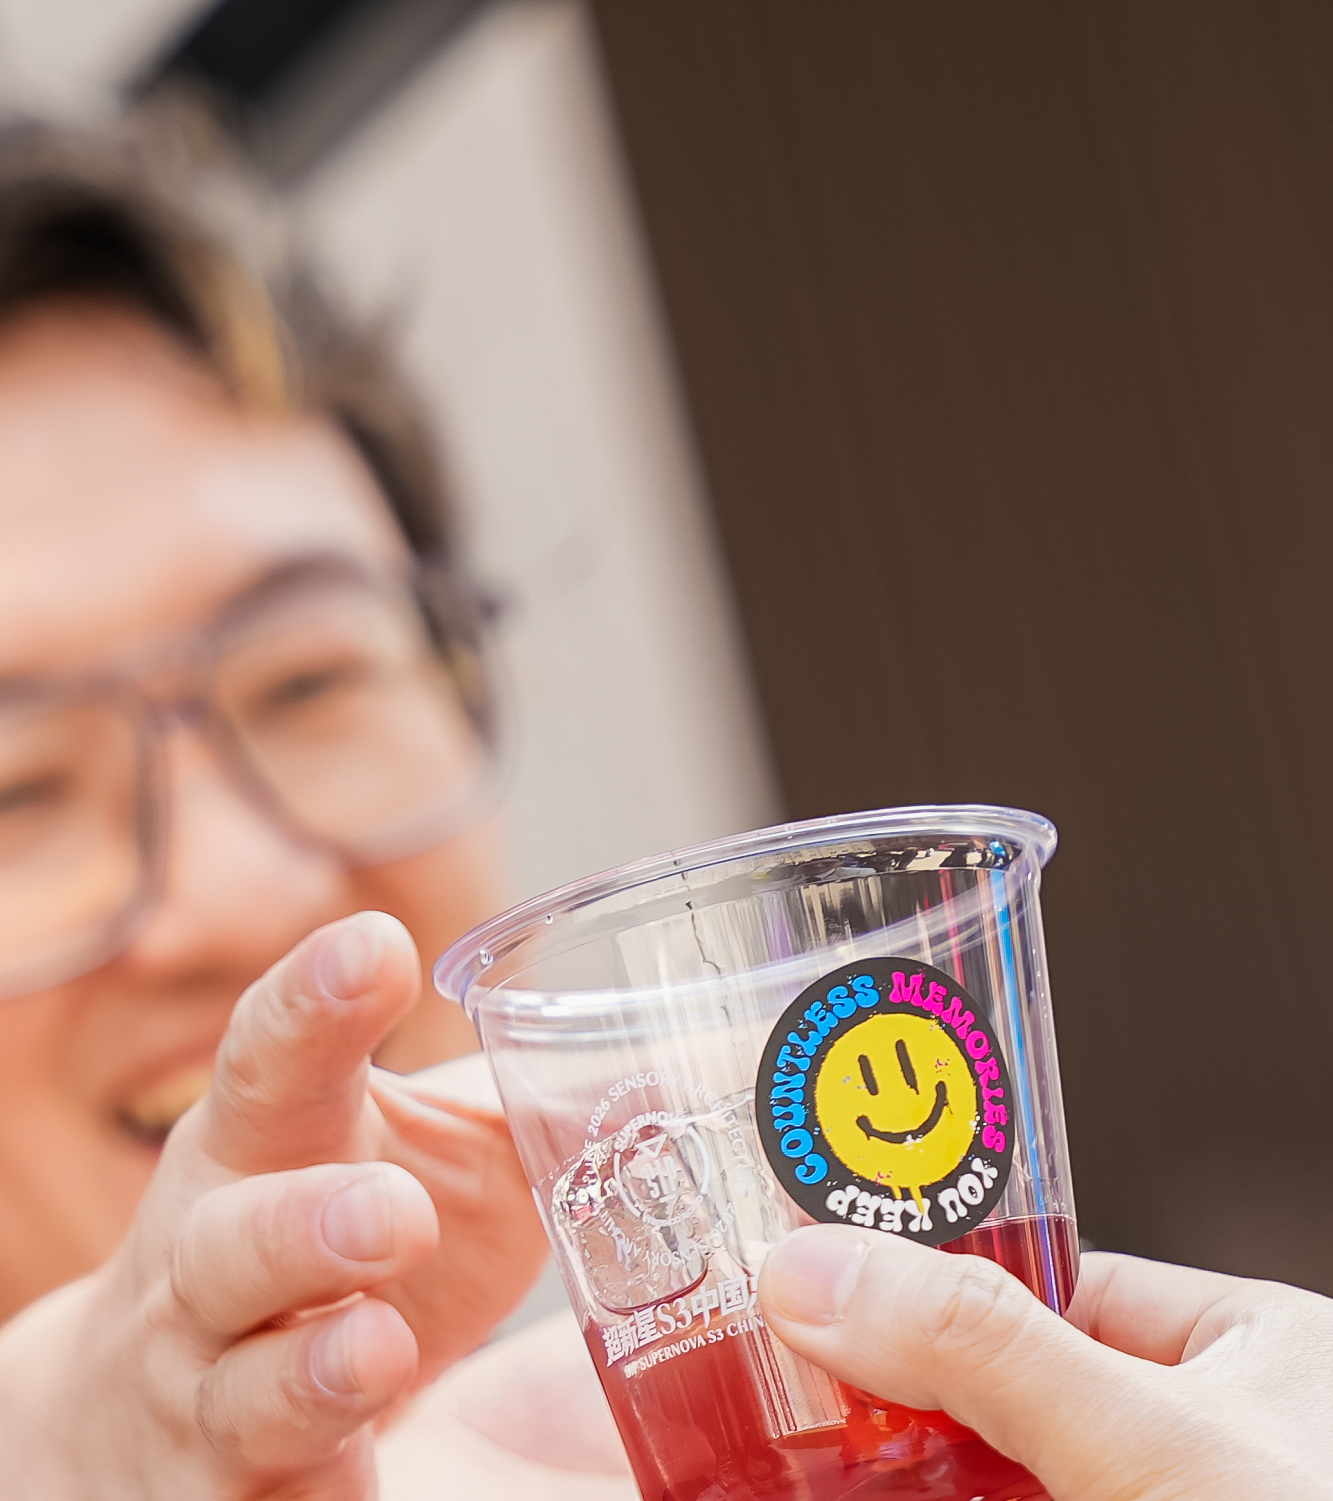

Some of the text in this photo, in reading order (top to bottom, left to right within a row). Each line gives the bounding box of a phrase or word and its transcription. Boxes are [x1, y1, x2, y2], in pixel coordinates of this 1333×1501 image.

[587, 1097, 611, 1138] 2026
[608, 1070, 681, 1103] SENSORY
[771, 971, 1008, 1185] COUNTLESS MEMORIES
[614, 1110, 689, 1154] SUPERNOV
[825, 1157, 998, 1234] YOU KEEP
[639, 1333, 707, 1371] SUPERNOVA
[708, 1328, 725, 1344] S3
[726, 1314, 766, 1337] CHIN
